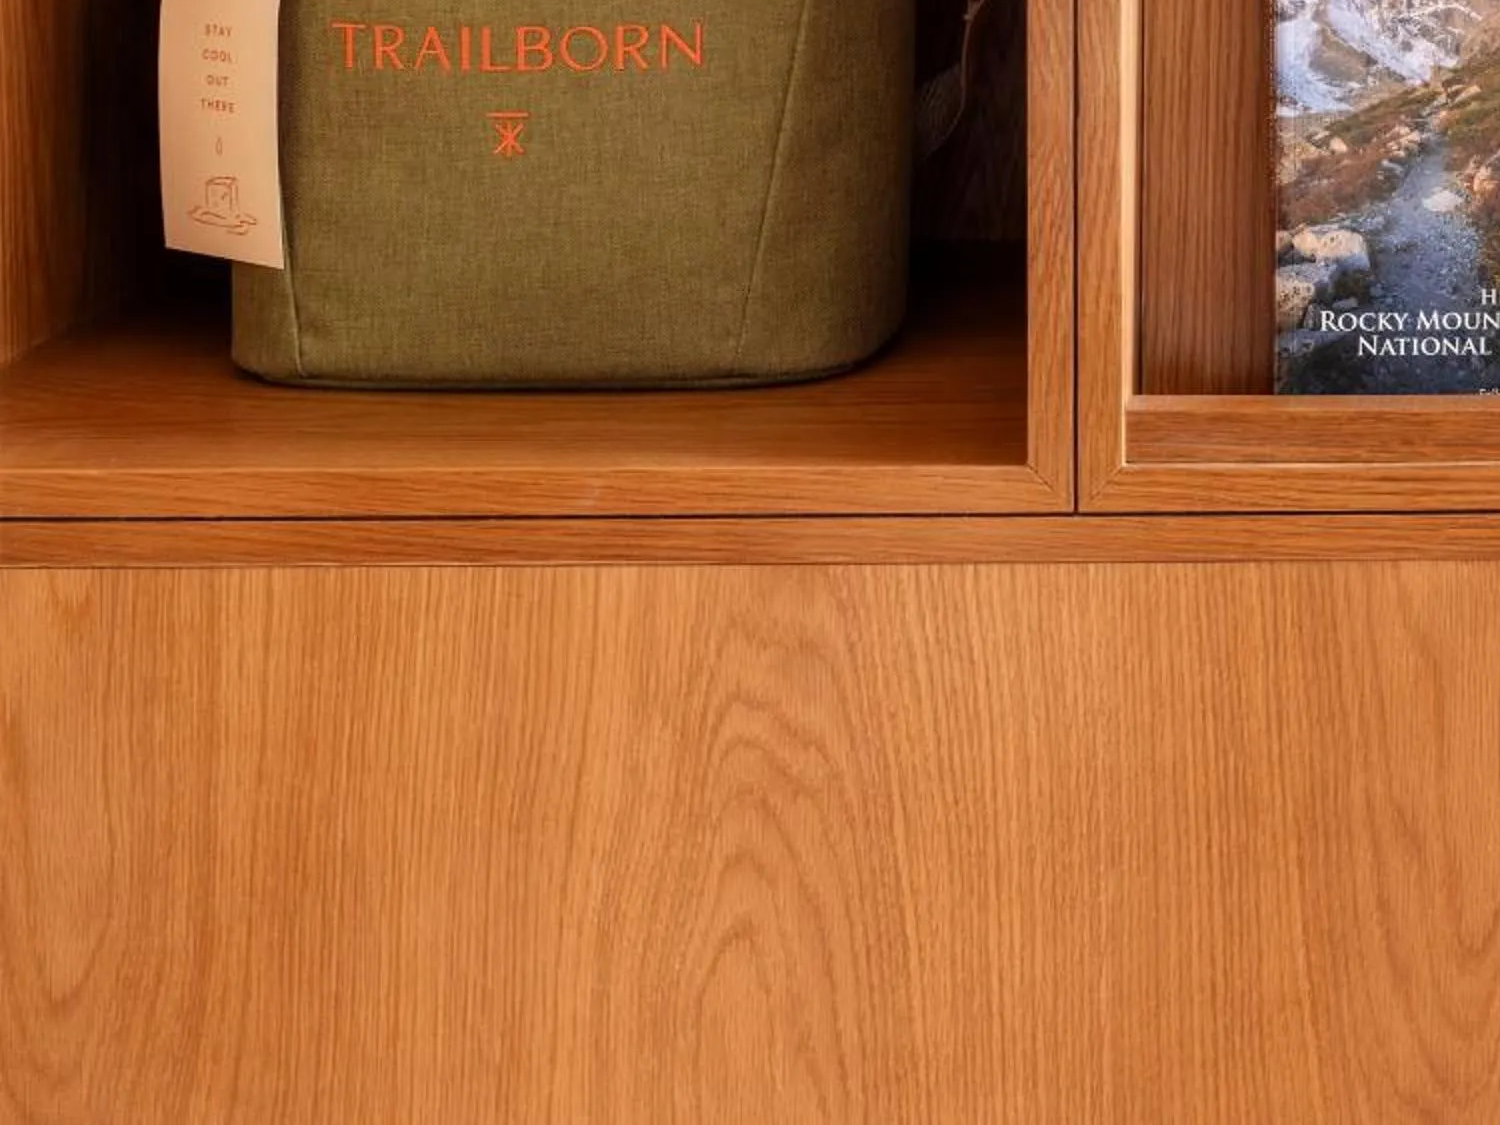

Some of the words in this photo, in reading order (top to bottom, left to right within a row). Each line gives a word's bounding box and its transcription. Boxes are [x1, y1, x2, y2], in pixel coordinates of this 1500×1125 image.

[205, 23, 232, 37] STAY
[331, 21, 704, 72] TRAILBORN
[202, 48, 232, 63] COOL
[206, 74, 229, 86] OUT
[201, 98, 235, 114] THERE
[1319, 310, 1409, 332] ROCKY
[1357, 334, 1493, 357] NATIONAL
